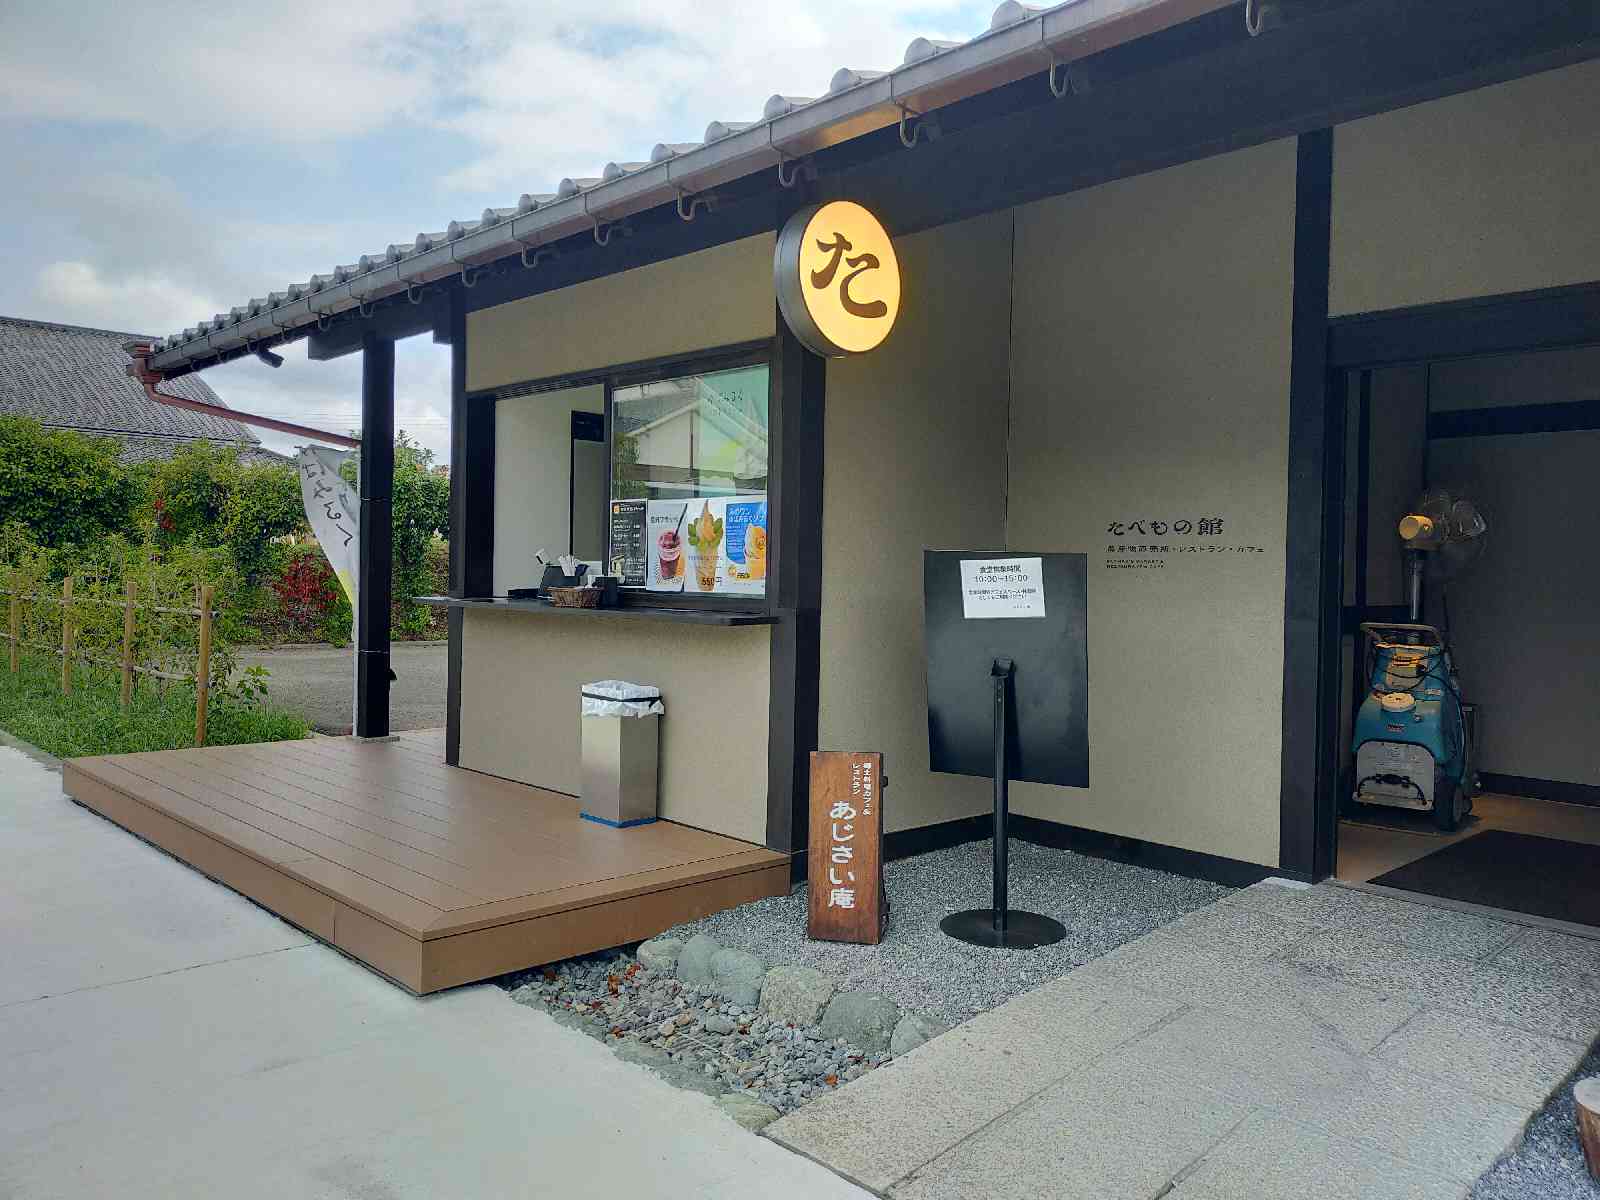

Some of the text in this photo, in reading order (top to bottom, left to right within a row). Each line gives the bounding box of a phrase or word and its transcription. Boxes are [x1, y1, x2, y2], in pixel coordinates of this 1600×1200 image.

[810, 232, 888, 318] た
[1106, 517, 1225, 536] たべもの館
[828, 800, 857, 909] あじさい庵
